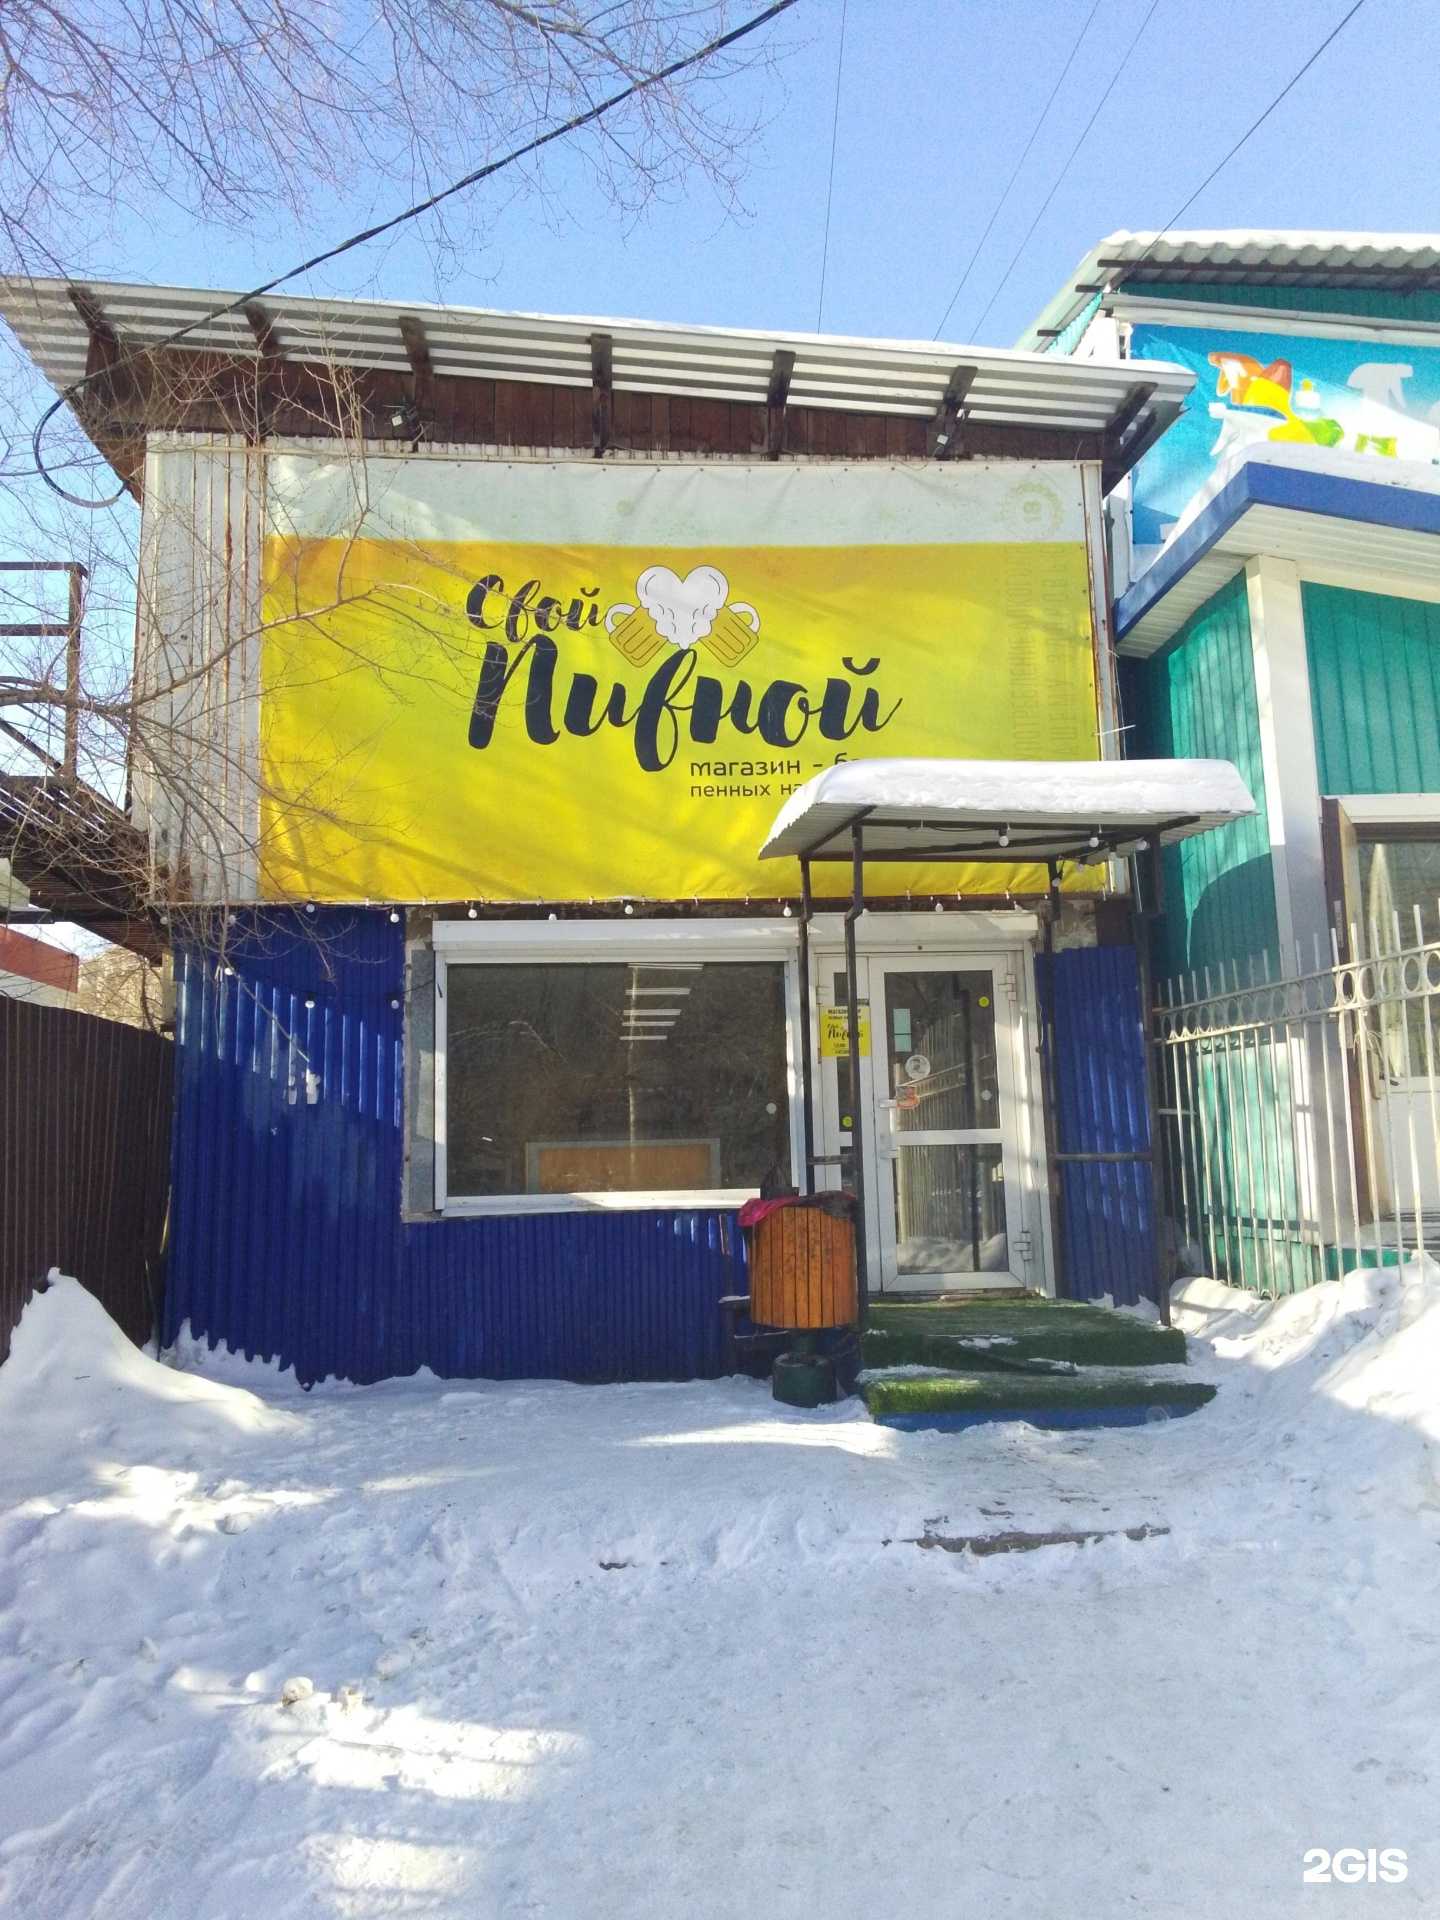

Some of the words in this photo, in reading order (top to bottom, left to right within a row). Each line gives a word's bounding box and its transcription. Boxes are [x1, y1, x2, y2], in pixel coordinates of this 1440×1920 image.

[465, 573, 605, 643] Свой
[468, 633, 903, 772] Пивной
[690, 759, 801, 777] магазин
[690, 783, 771, 798] пенных
